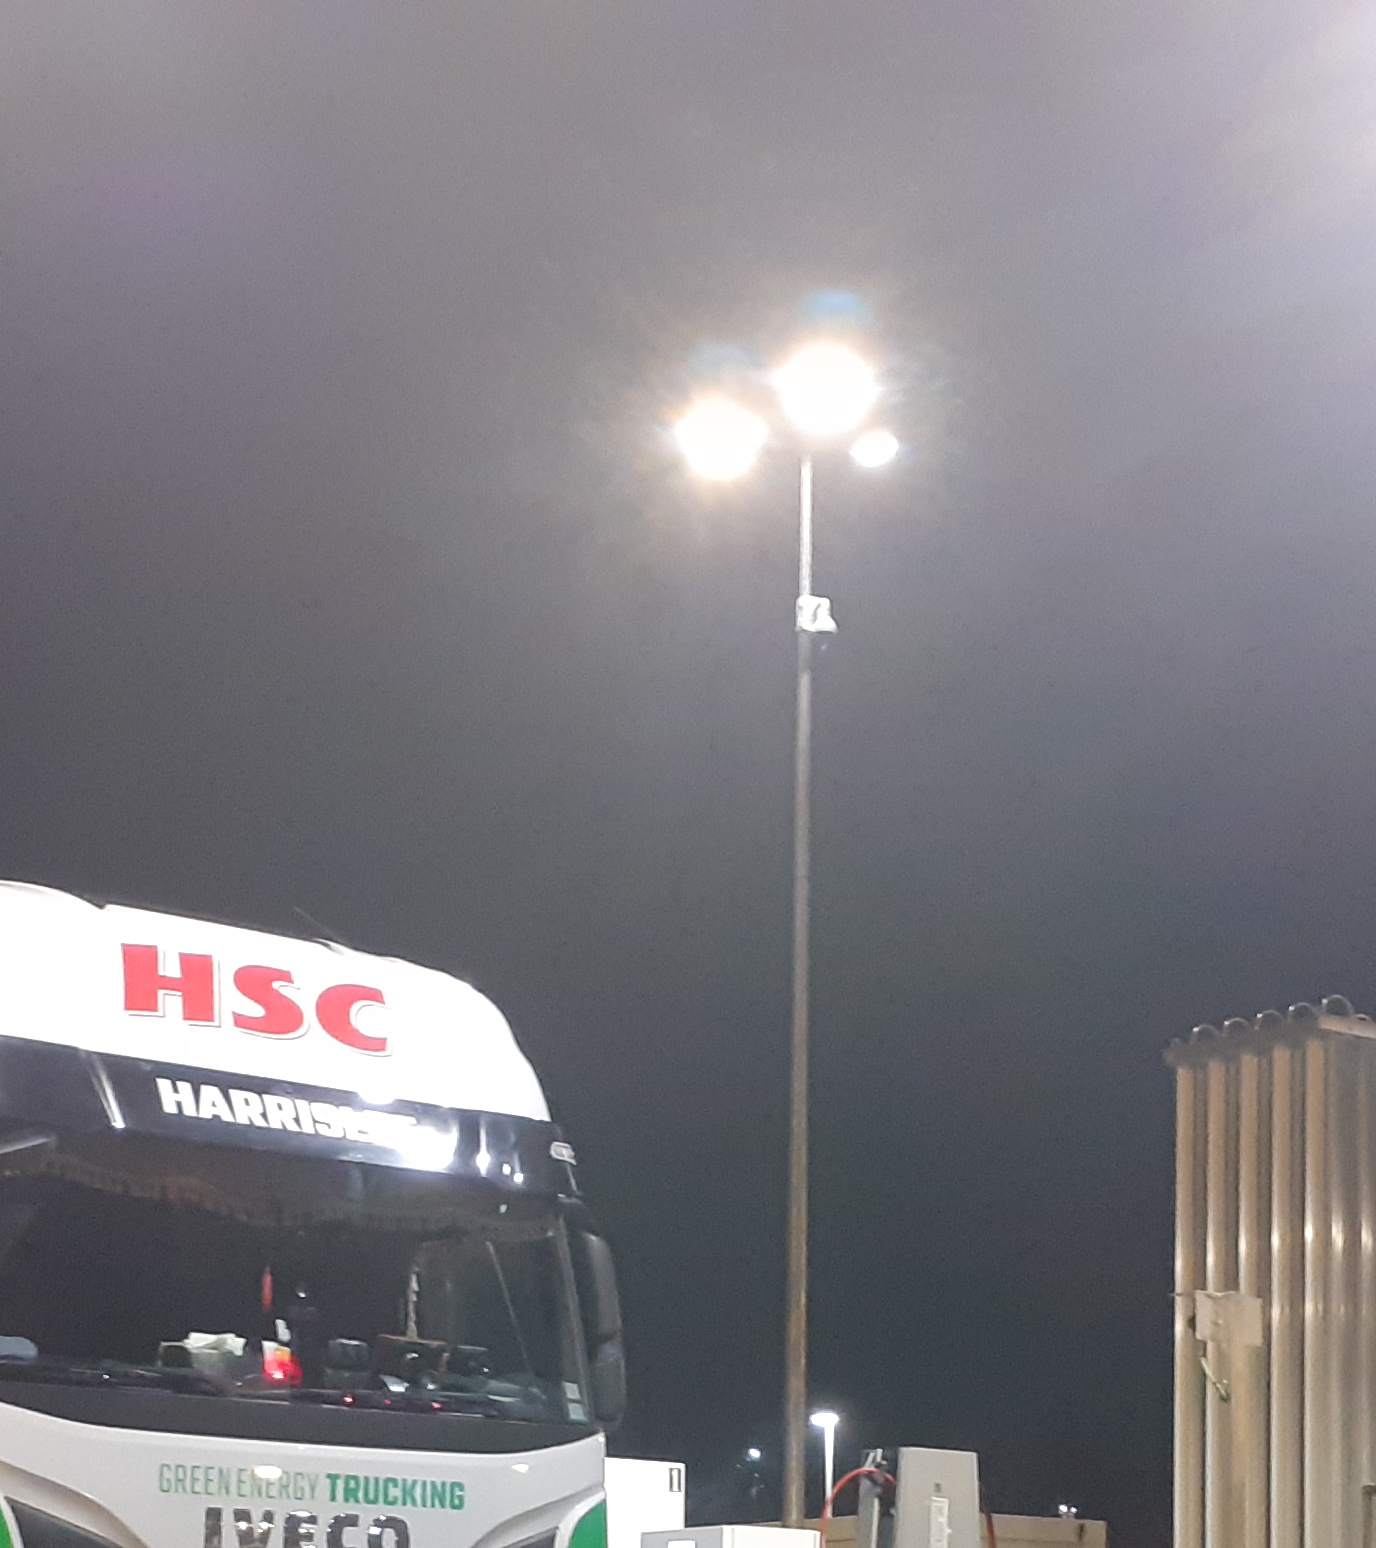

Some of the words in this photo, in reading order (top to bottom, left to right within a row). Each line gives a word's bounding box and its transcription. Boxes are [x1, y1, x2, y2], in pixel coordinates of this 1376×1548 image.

[121, 942, 392, 1056] HSC
[159, 1463, 230, 1497] GREEN
[236, 1467, 320, 1501] ENERGY
[326, 1472, 467, 1511] TRUCKING
